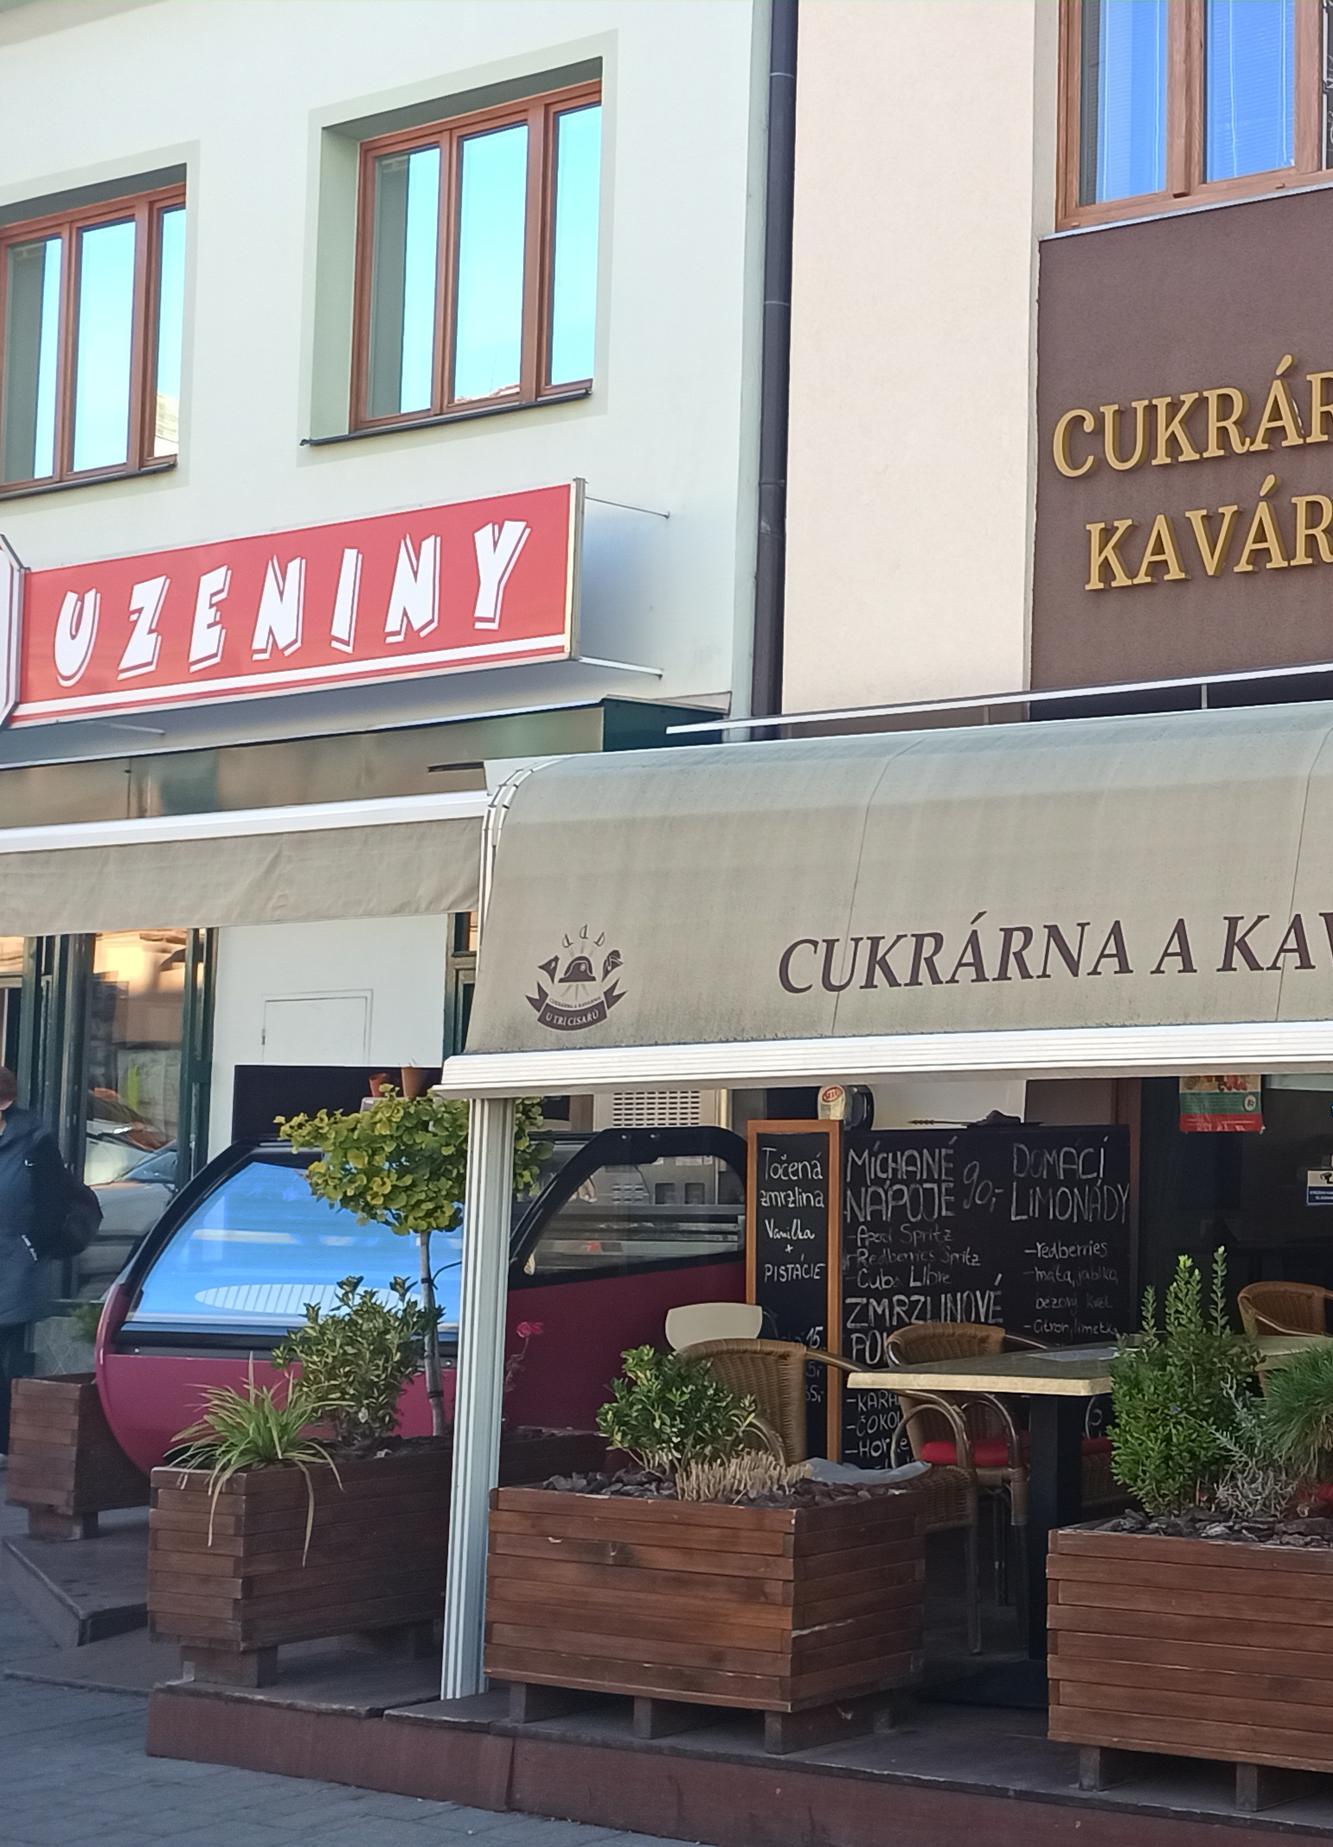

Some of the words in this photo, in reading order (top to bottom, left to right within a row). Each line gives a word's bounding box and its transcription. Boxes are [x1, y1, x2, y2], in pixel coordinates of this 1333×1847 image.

[53, 519, 531, 688] UZENINY
[777, 910, 1135, 995] CUKRÁRNA
[1149, 917, 1199, 976] A
[762, 1147, 824, 1181] Točená
[846, 1135, 959, 1186] MÍCHANÉ
[760, 1187, 825, 1208] zmrzlina
[846, 1180, 956, 1223] NÁPOJE
[1010, 1179, 1130, 1224] LIMONÁDY
[764, 1253, 826, 1283] PISTÁCIE
[845, 1273, 1003, 1328] ZMRZLINOVÉ
